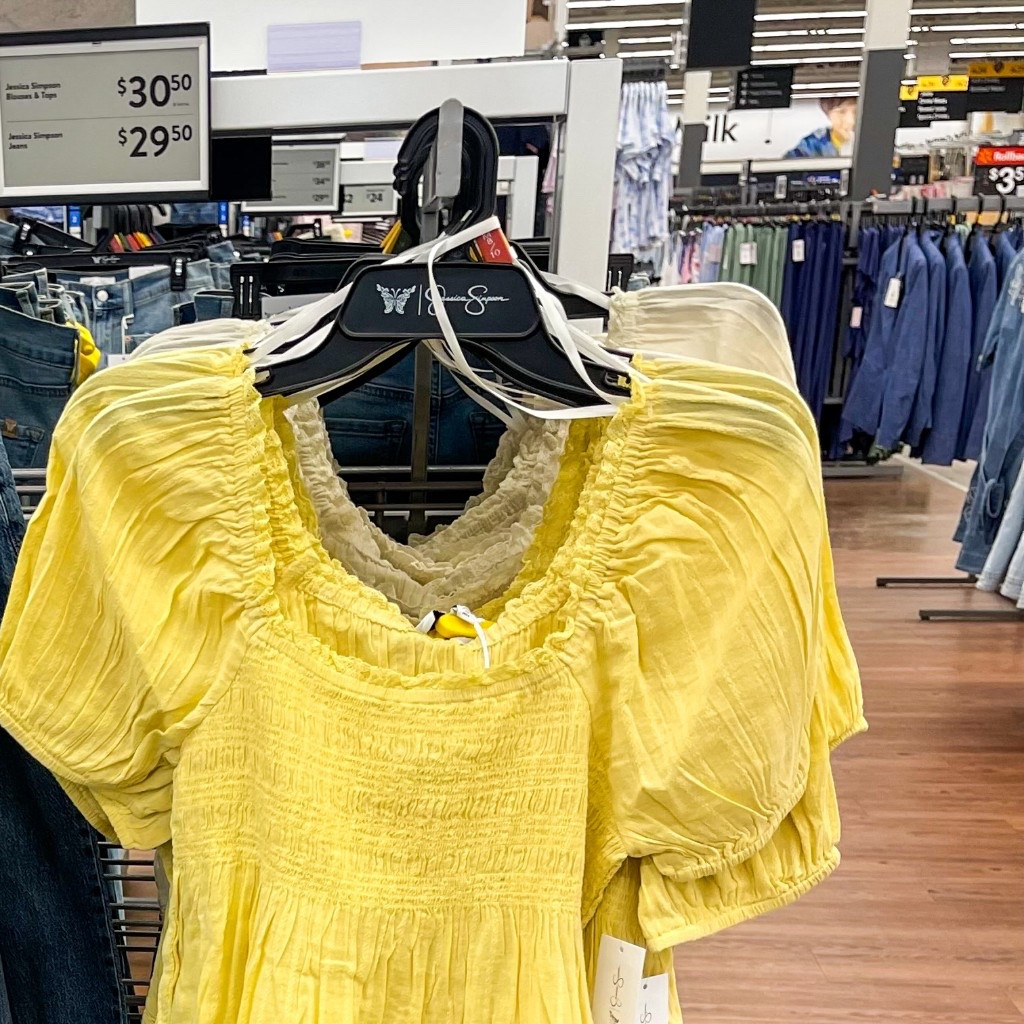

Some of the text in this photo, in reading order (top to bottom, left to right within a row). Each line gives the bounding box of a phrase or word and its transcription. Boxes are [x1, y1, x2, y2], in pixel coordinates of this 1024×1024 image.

[5, 82, 61, 91] Jessica Simpson
[41, 91, 57, 100] Tops
[704, 113, 738, 142] ilk
[34, 132, 63, 141] Simpson
